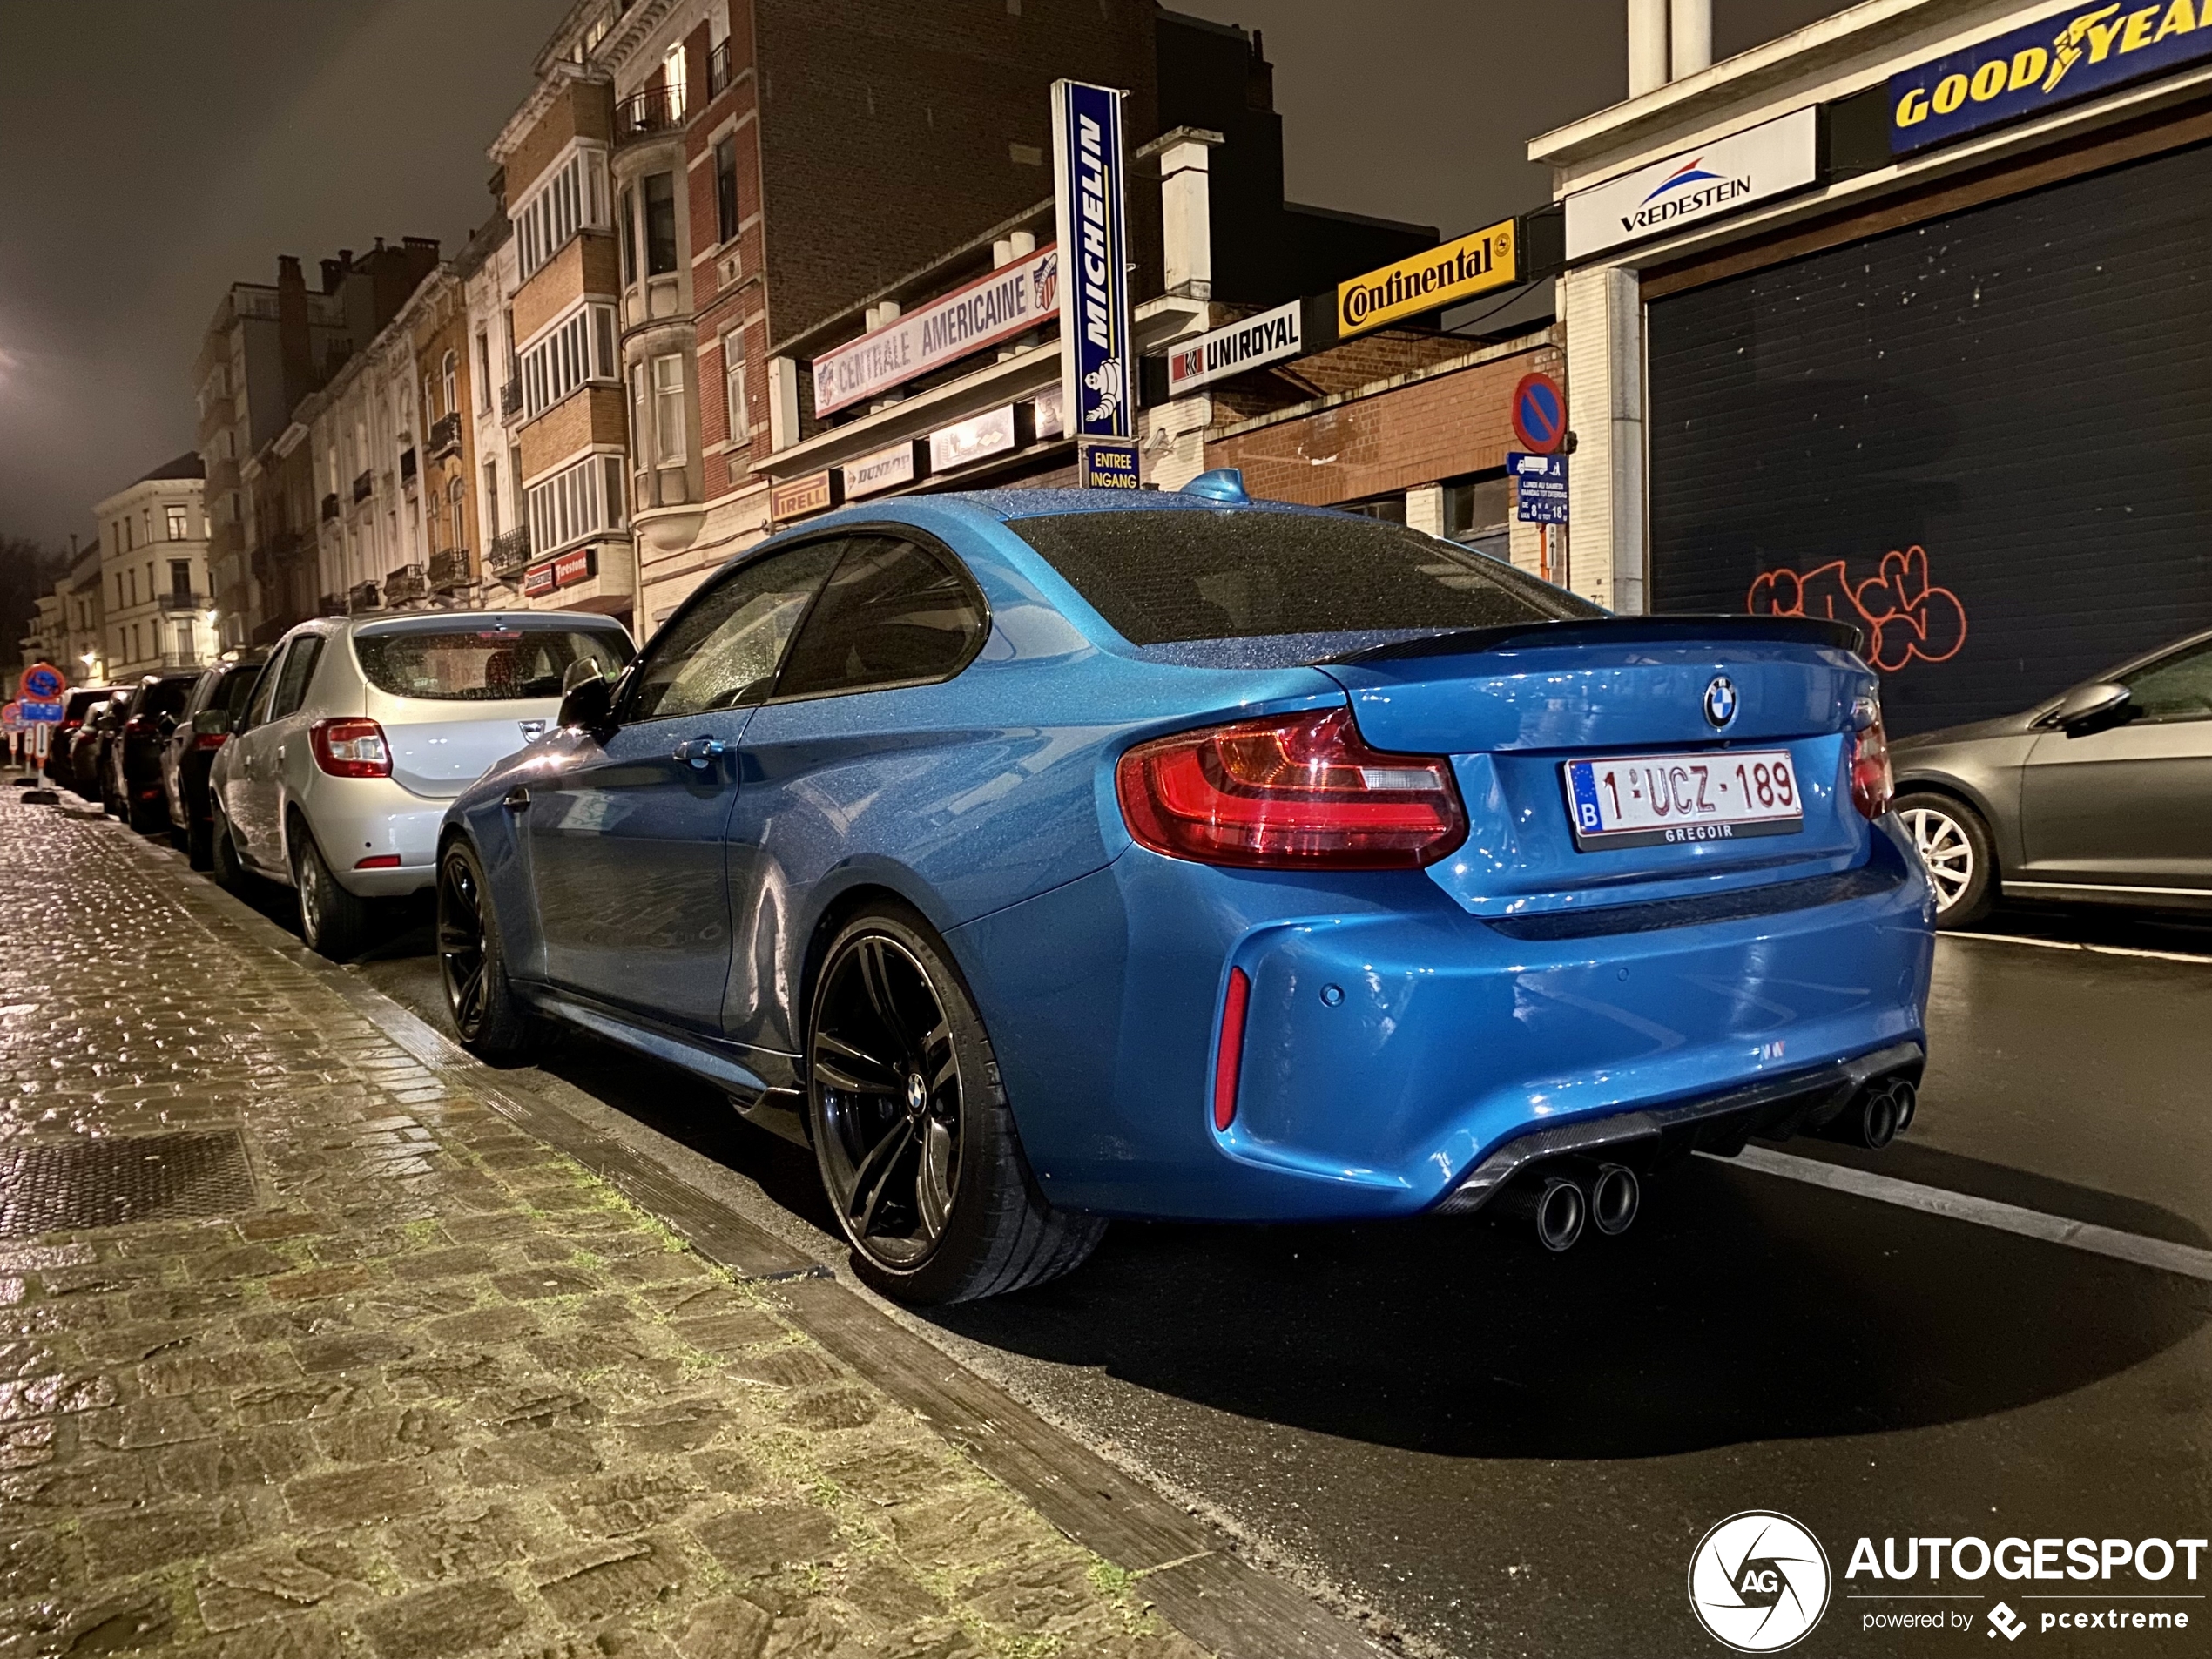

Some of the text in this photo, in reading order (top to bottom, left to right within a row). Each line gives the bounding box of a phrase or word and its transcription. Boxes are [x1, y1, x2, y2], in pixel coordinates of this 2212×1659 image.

[1621, 175, 1750, 233] VREDESTEIN
[1079, 113, 1109, 350] MICHELIN
[1343, 237, 1493, 327] Continental
[839, 330, 911, 393] CENTRALE
[922, 274, 1026, 357] AMERICAINE
[1207, 314, 1298, 372] UNIROYAL
[858, 454, 911, 484] DUNLOP
[1095, 452, 1132, 469] ENTREE
[772, 475, 827, 517] PIRELLI
[1091, 471, 1137, 489] INGANG
[1531, 504, 1537, 517] 8
[1552, 506, 1562, 519] 18
[1581, 803, 1599, 827] B
[1665, 824, 1733, 843] GREGOIR
